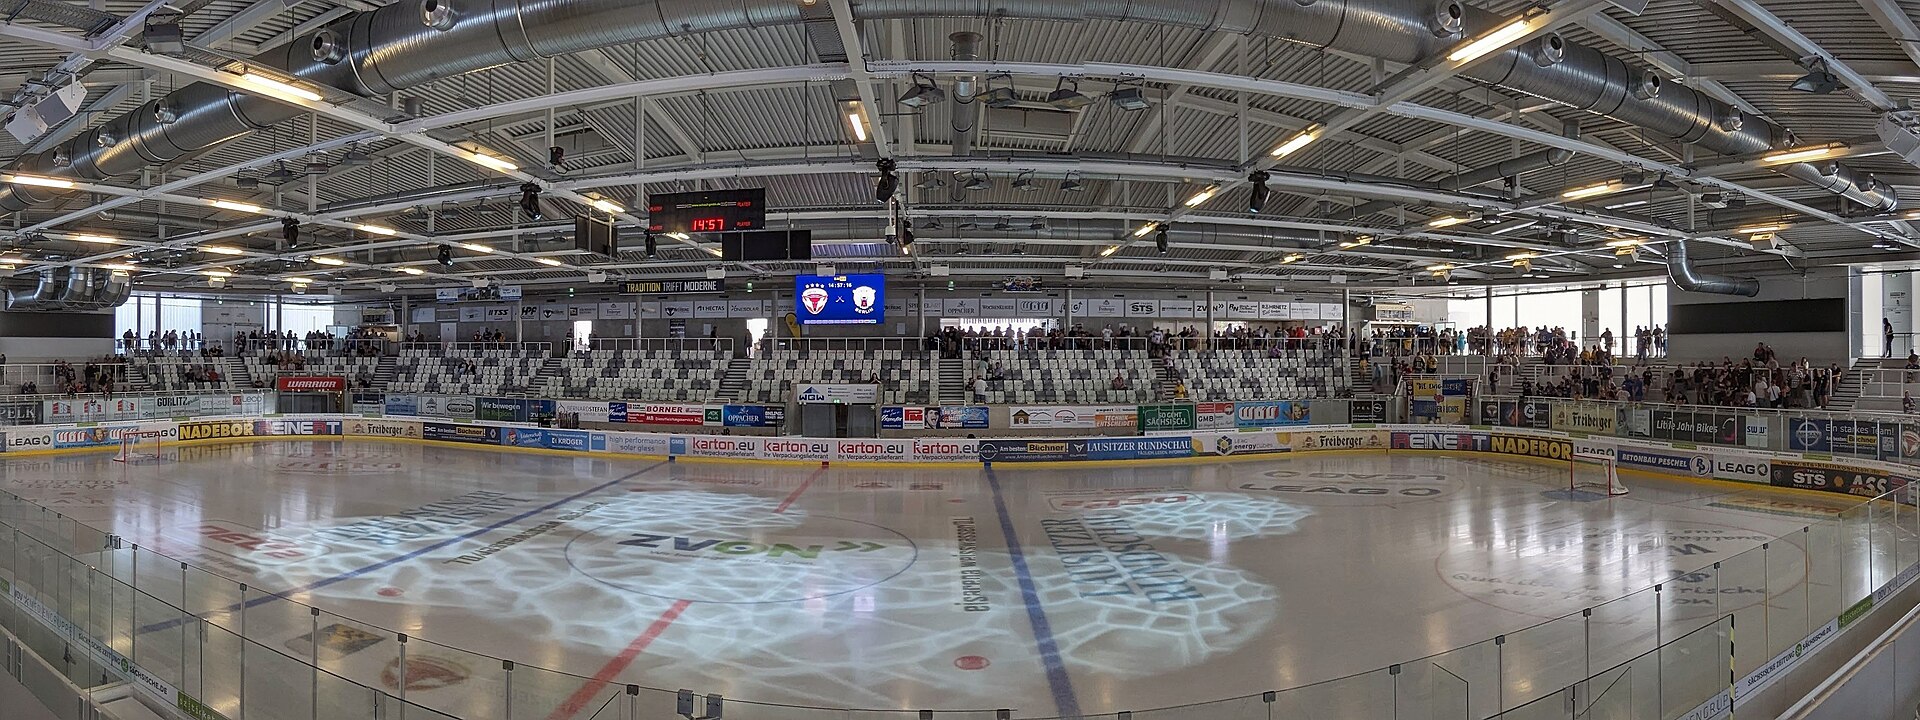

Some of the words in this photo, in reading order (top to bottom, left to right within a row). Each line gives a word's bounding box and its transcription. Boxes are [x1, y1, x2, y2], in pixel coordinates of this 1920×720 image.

[693, 219, 724, 231] 14:57
[627, 282, 661, 293] TRADITION
[663, 281, 682, 292] TRIFFT
[684, 280, 717, 291] MODERNE
[1131, 304, 1154, 313] STS
[1197, 304, 1218, 312] ZVN
[157, 396, 188, 407] GÖRLITZ
[492, 402, 521, 411] bewegen
[646, 405, 683, 413] BÖRNER
[728, 414, 760, 423] OPPACHER
[1571, 411, 1613, 431] Freiberger
[179, 421, 254, 440] NADEBOR
[260, 420, 342, 437] REINERT
[366, 423, 404, 437] Freiberger
[1657, 419, 1675, 430] Little
[1676, 421, 1693, 432] John
[1696, 423, 1718, 434] Bikes
[1825, 423, 1838, 432] En
[8, 437, 41, 447] LEAG
[609, 436, 622, 446] high
[624, 437, 667, 446] performance
[692, 438, 755, 453] karton.eu
[764, 440, 829, 453] karton.eu
[838, 441, 904, 454] karton.eu
[1087, 441, 1136, 452] LAUSITZER
[1137, 440, 1191, 452] RUNDSCHAU
[1319, 434, 1364, 449] Freiberger
[1393, 433, 1487, 450] REINERT
[637, 445, 655, 453] glass
[913, 442, 980, 455] karton.eu
[1028, 443, 1070, 453] Büchner!
[1491, 436, 1573, 460] NADEBOR
[700, 450, 755, 460] Verpackungslieferant
[772, 452, 829, 461] Verpackungslieferant
[845, 454, 905, 463] Verpackungslieferant
[1622, 454, 1657, 464] BETONBAU
[1658, 458, 1688, 468] PESCHEL
[1718, 461, 1756, 475] LEAG
[1793, 472, 1827, 486] STS
[1240, 484, 1390, 496] LEAG
[617, 533, 824, 559] ZVON
[1041, 518, 1136, 599] LAUSITZER
[1082, 514, 1205, 603] RUNDSCHAU
[953, 566, 991, 613] eisarena
[1747, 662, 1776, 688] SÄCHSISCHE
[1775, 650, 1795, 672] ZEITUNG
[1802, 625, 1832, 651] SÄCHSISCHE.DE
[129, 664, 169, 696] SÄCHSISCHE.DE
